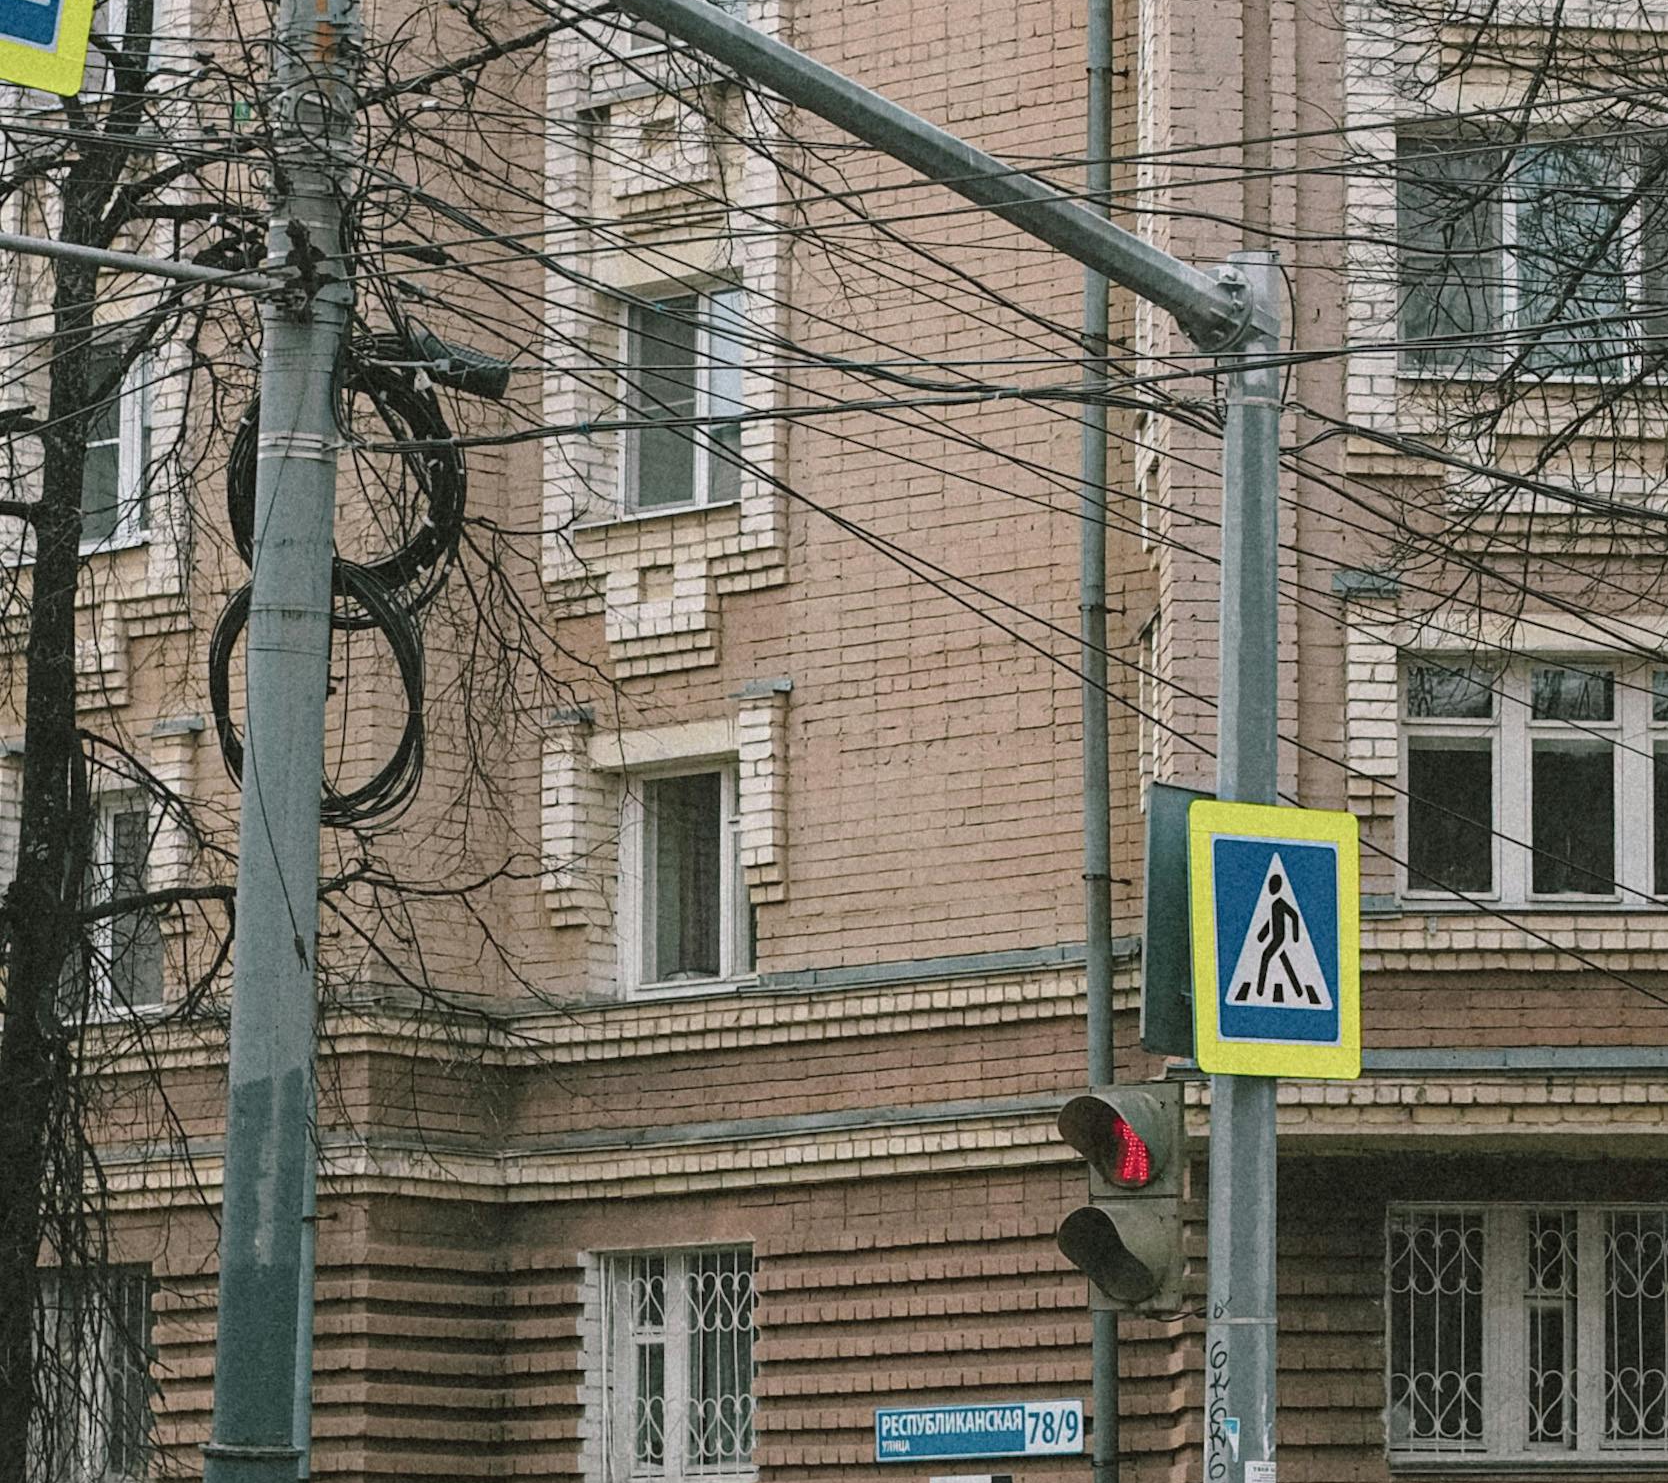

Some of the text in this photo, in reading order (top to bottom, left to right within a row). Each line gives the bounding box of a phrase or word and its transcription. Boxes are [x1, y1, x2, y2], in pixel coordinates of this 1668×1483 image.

[881, 1408, 1079, 1445] РЕСПУБЛИКАНСКАЯ 78/9
[881, 1439, 911, 1453] УЛИЦА
